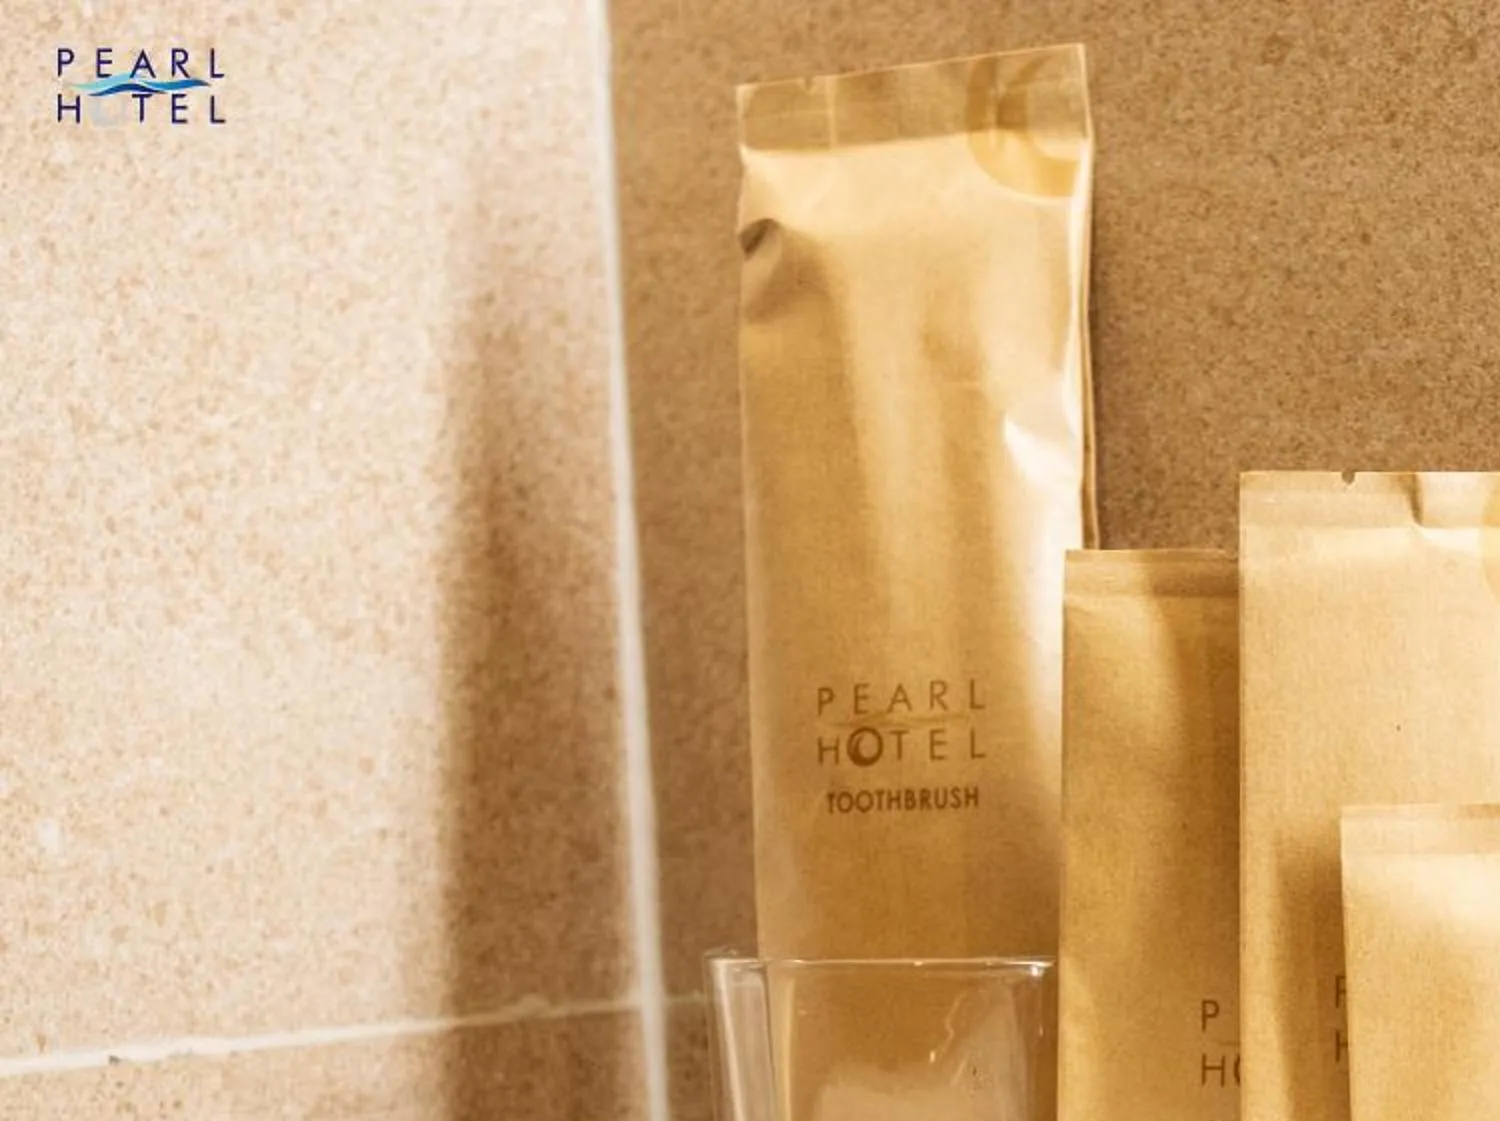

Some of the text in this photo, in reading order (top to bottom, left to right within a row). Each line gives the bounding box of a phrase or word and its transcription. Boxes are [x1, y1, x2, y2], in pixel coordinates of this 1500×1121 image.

[817, 678, 986, 717] PEARL
[817, 726, 987, 767] HOTEL
[827, 786, 979, 815] TOOTHBRUSH
